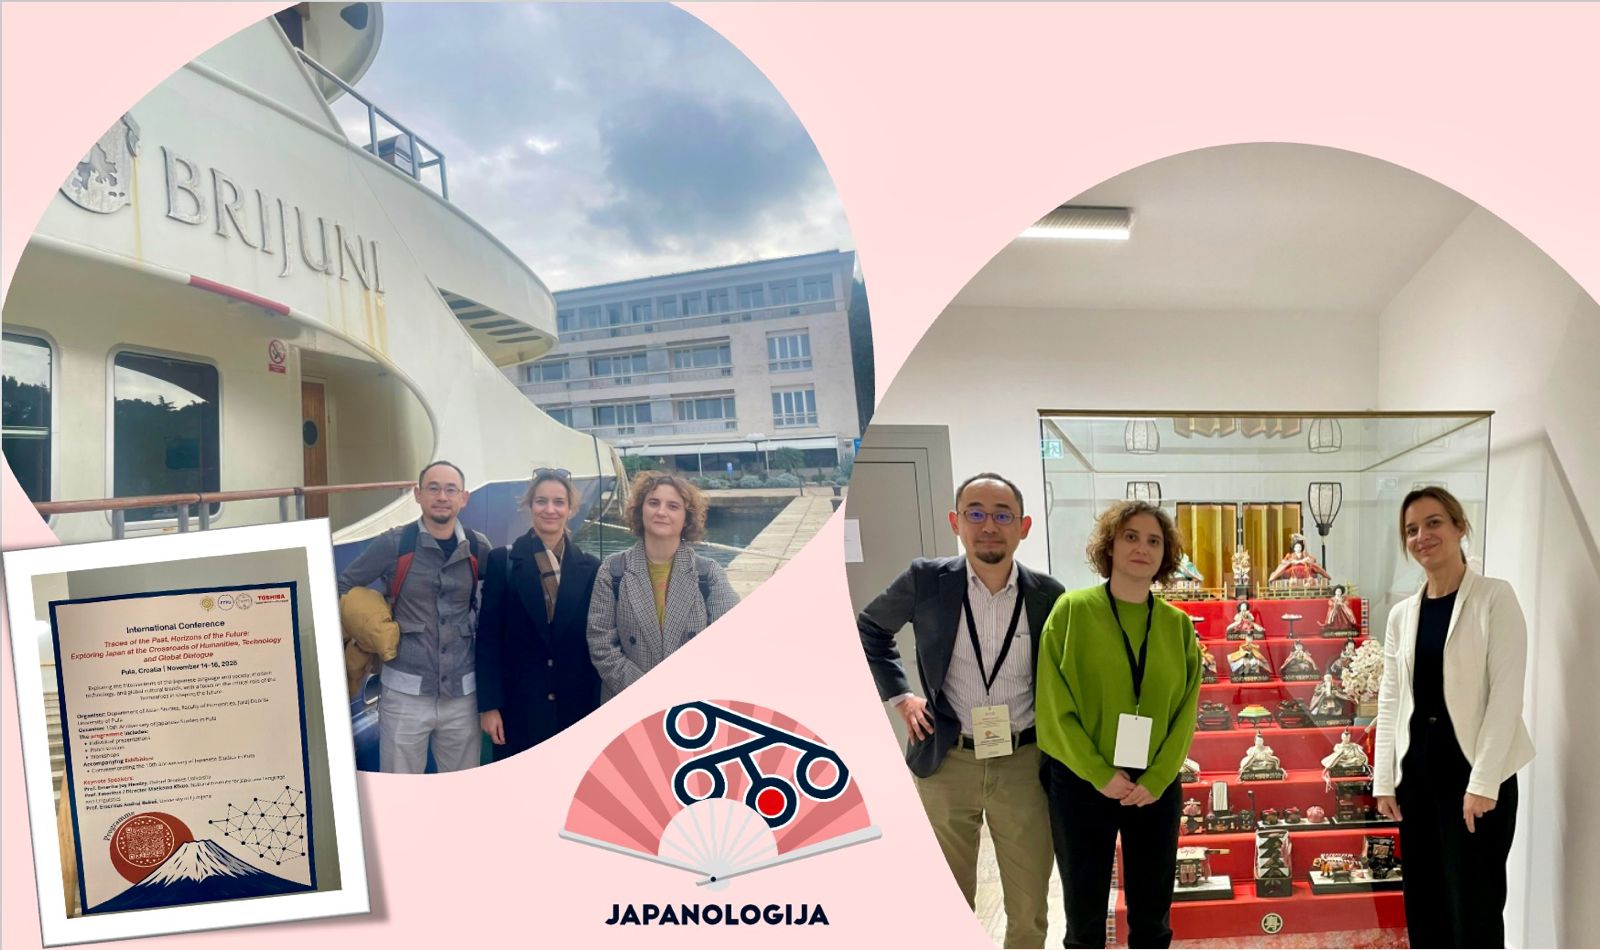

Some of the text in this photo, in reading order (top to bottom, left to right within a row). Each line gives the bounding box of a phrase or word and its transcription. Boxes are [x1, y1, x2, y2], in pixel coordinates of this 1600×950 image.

[161, 145, 385, 294] BRIJUNI
[126, 619, 224, 633] International Conference
[104, 639, 127, 647] Traces
[170, 633, 201, 642] Horizons
[70, 650, 104, 660] Exploring
[104, 649, 125, 657] Japan
[148, 644, 189, 653] Crossroads
[199, 639, 240, 649] Humanities,
[242, 636, 281, 646] Technology
[158, 653, 181, 661] Global
[182, 650, 213, 660] Dialogue
[166, 663, 199, 671] November
[103, 811, 136, 841] Programme
